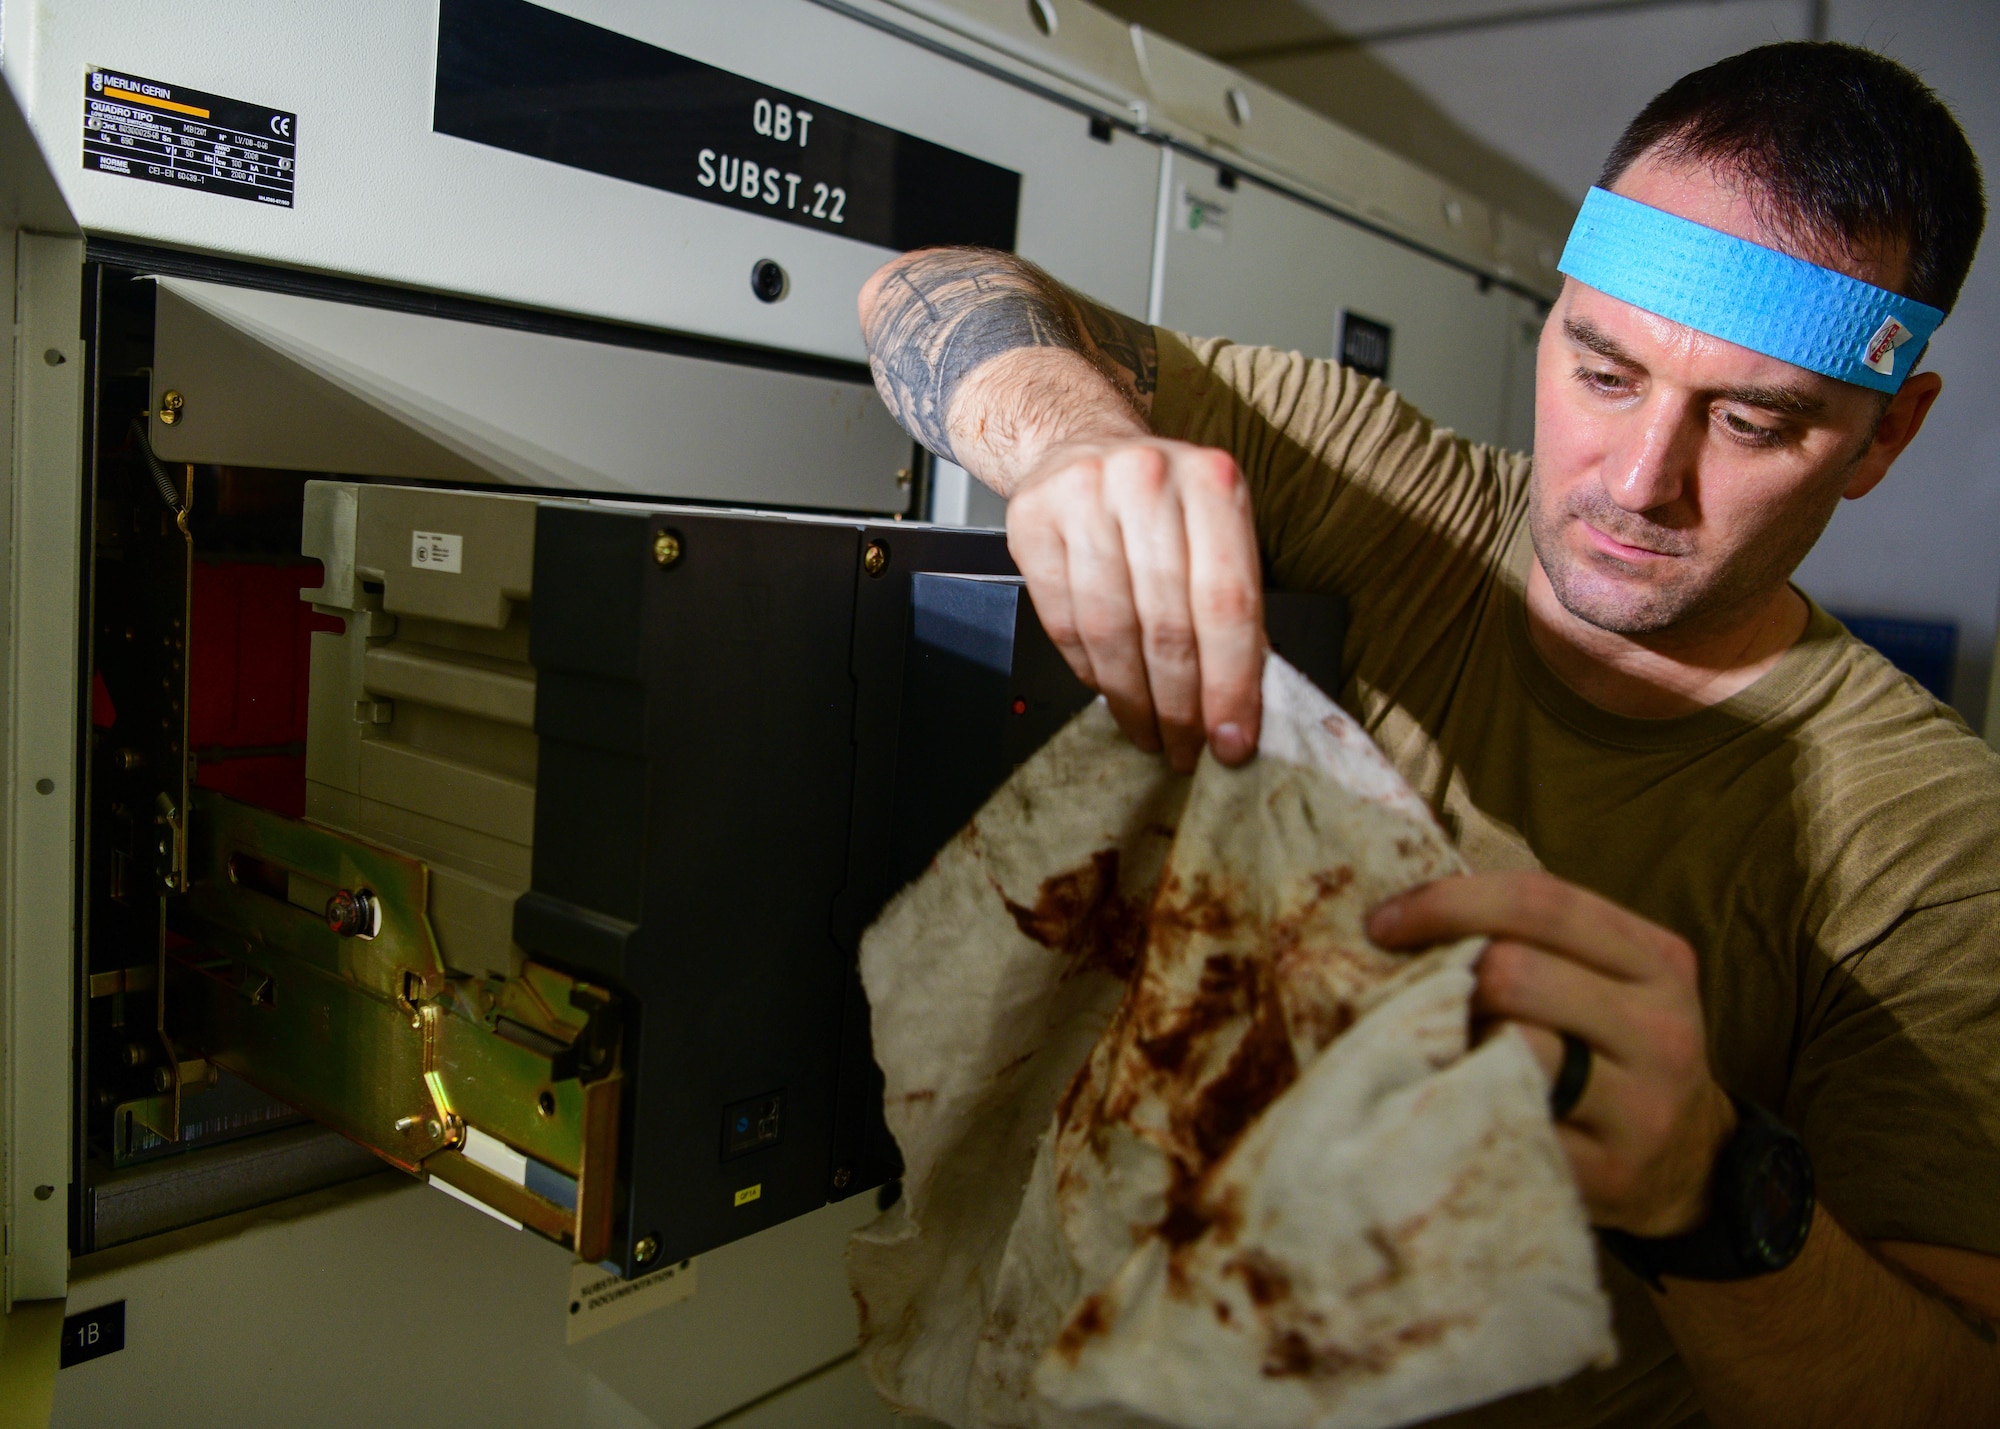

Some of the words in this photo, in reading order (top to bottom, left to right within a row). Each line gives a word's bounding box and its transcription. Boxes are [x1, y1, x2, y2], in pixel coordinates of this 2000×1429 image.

[104, 74, 140, 92] MERLIN
[142, 84, 170, 100] GERIN
[91, 102, 131, 117] QUADRO
[132, 111, 153, 122] TIPO
[104, 114, 126, 122] VOLTAGE
[160, 124, 172, 132] TYPE
[270, 115, 290, 137] CE
[753, 97, 813, 148] QBT
[165, 146, 171, 154] V
[185, 150, 194, 158] 50
[204, 155, 213, 163] Hz
[100, 156, 128, 167] NORME
[231, 160, 242, 168] 100
[250, 164, 259, 172] kA
[148, 166, 174, 178] CEI-EN
[178, 172, 204, 184] 60439-1
[697, 148, 846, 223] SUBST.22
[581, 1275, 620, 1297] SUBSTA
[77, 1322, 100, 1347] 1B
